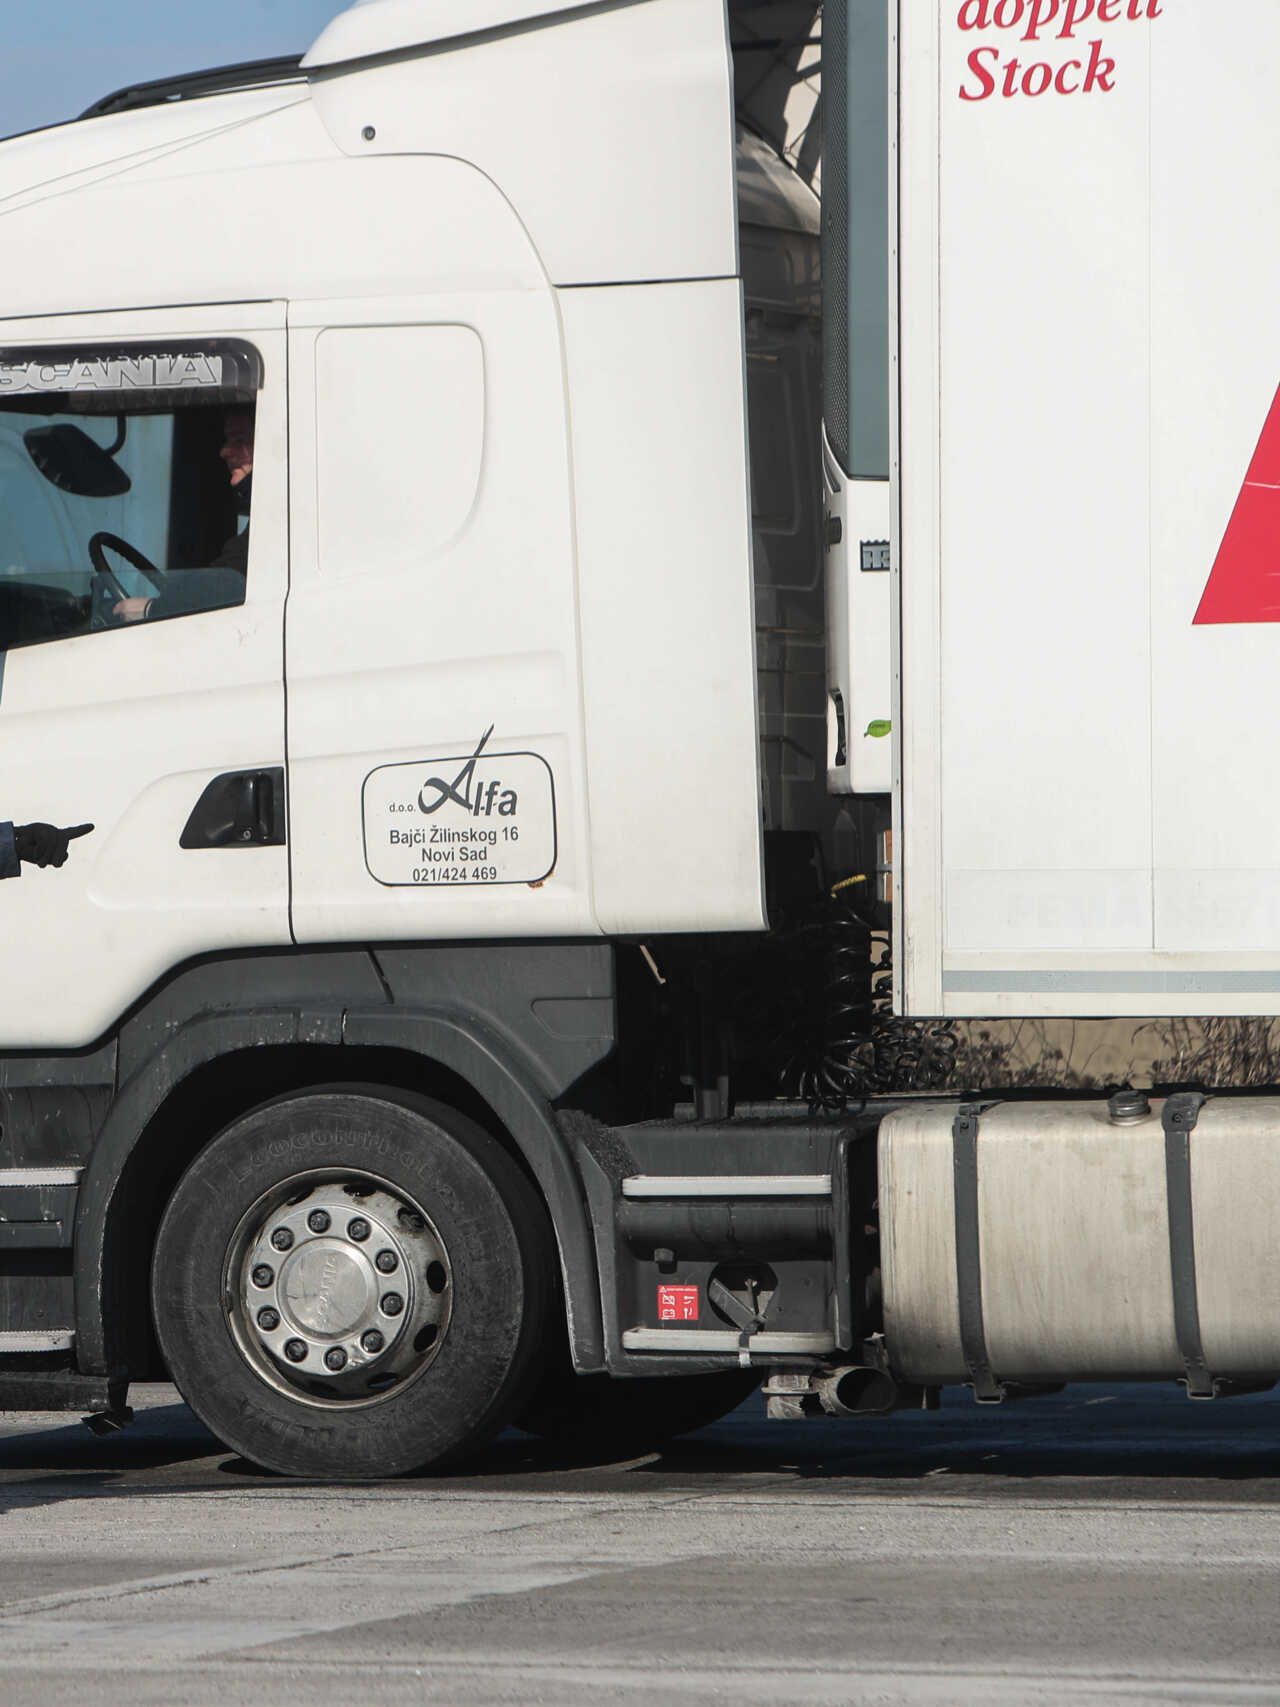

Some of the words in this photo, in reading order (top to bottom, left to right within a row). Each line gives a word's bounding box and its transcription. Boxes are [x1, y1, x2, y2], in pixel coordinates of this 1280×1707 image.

[959, 39, 1115, 101] Stock
[388, 802, 417, 814] d.o.o.
[417, 724, 518, 816] Alfa
[389, 827, 426, 848] Bajči
[429, 825, 497, 846] Žilinskog
[502, 825, 519, 841] 16
[421, 847, 455, 862] Novi
[459, 846, 488, 861] Sad
[412, 866, 468, 882] 021/424
[471, 866, 497, 881] 469
